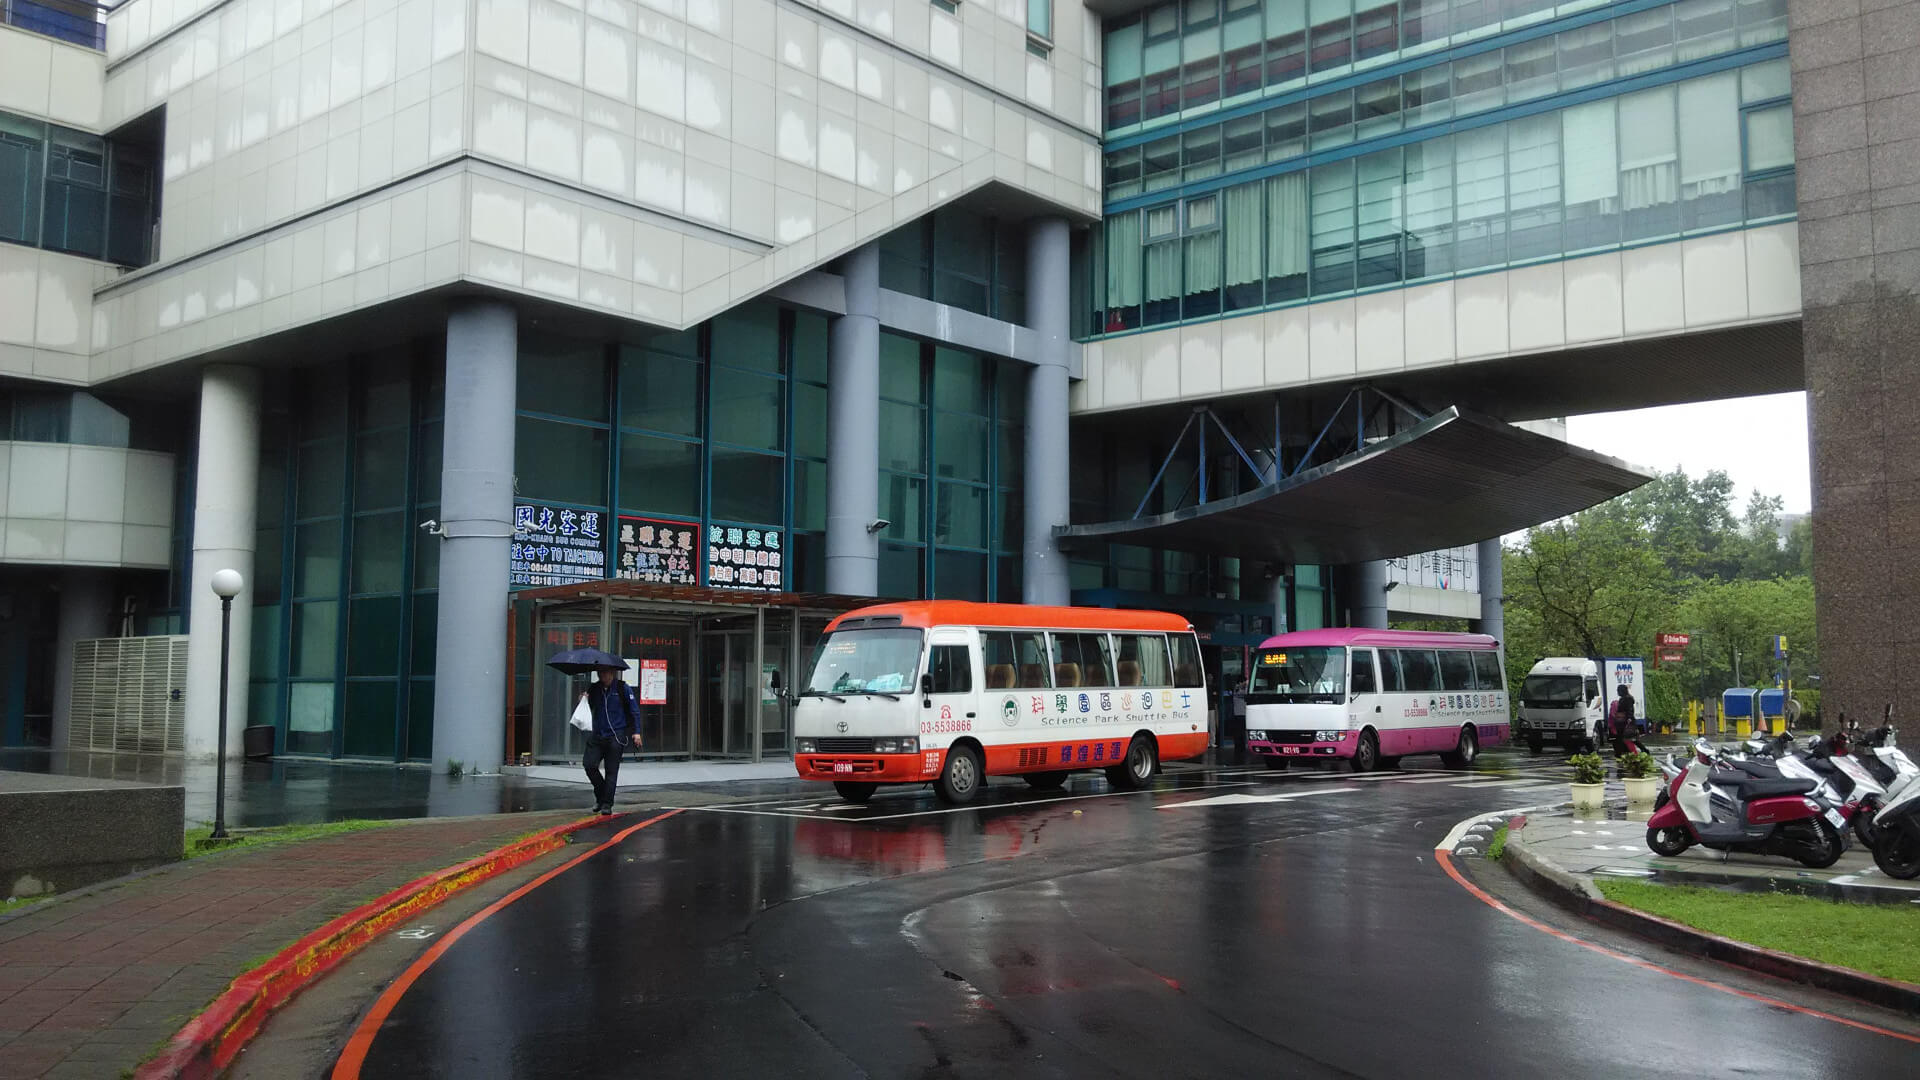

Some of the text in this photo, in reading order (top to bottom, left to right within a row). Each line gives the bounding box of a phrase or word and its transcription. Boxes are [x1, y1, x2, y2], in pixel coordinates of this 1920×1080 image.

[515, 506, 600, 538] 國光客運
[710, 526, 780, 549] 統聯客運
[1031, 690, 1191, 715] 科學園區巡迴巴士
[920, 719, 972, 734] 03-5538866
[1041, 711, 1189, 727] Science Park Shuttle Bus
